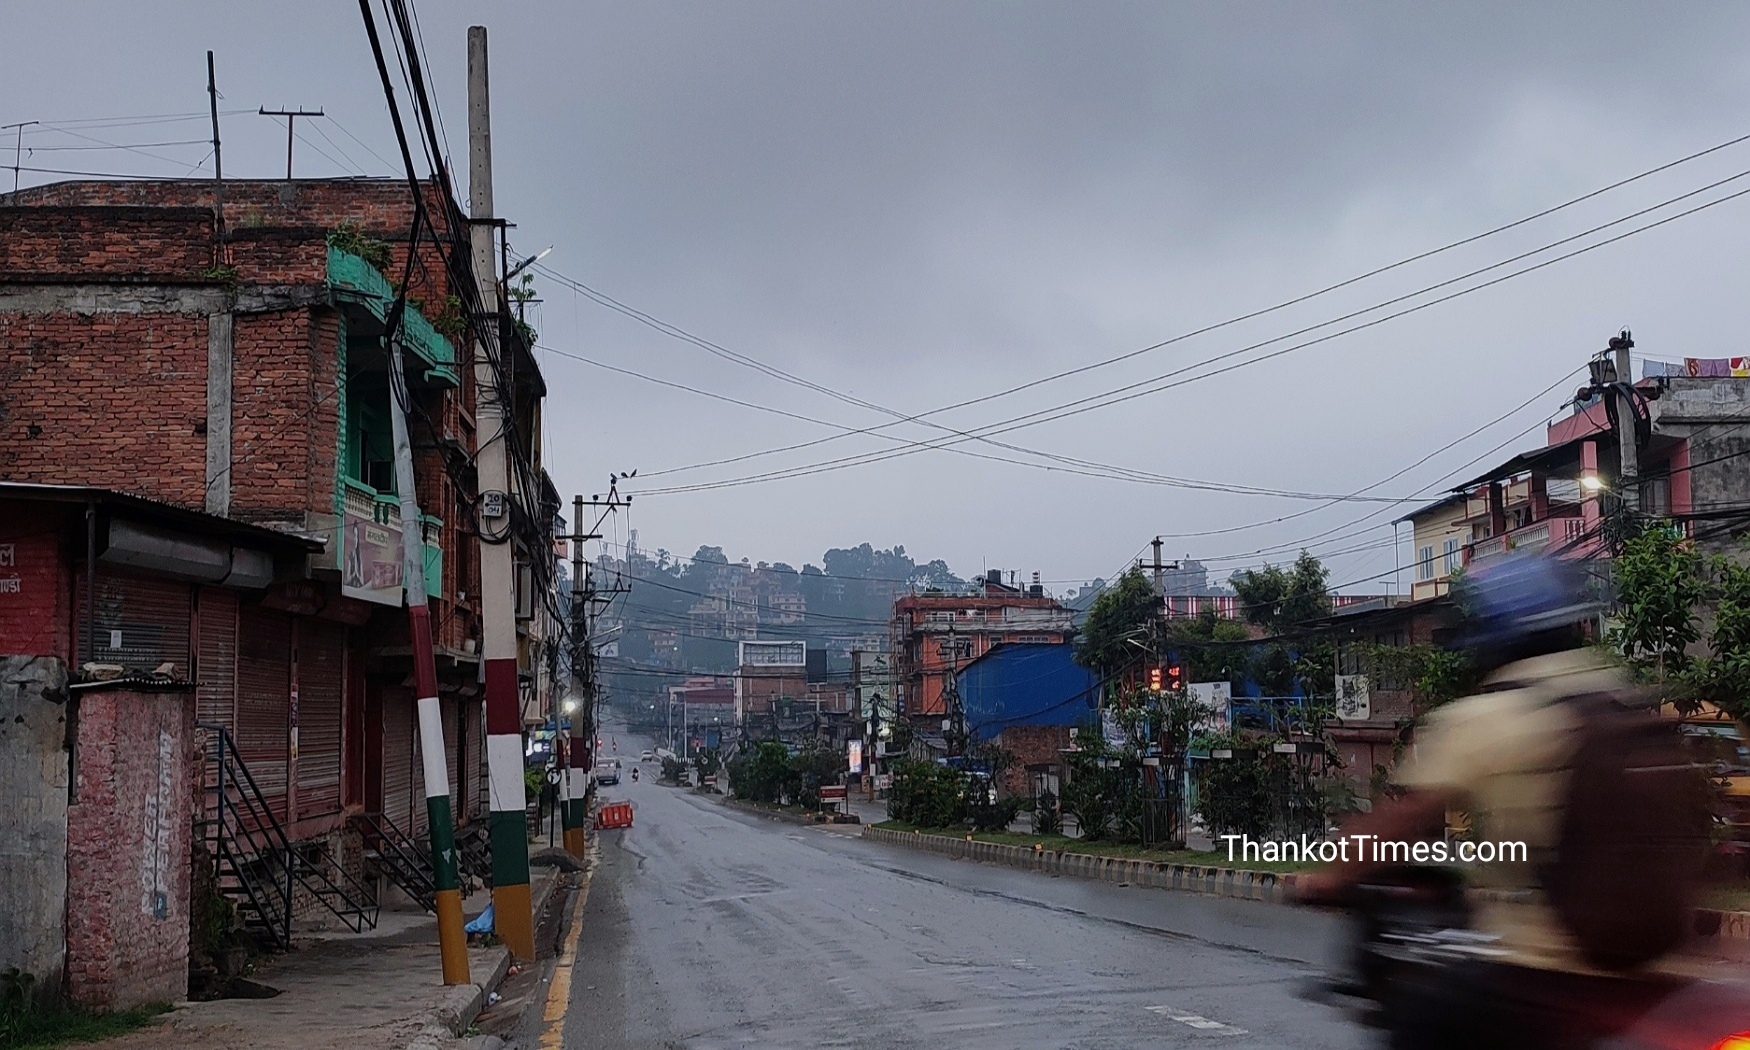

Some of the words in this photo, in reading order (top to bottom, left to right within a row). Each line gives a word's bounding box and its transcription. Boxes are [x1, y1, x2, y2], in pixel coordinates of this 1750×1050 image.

[488, 494, 500, 503] 20
[0, 543, 15, 567] ल
[142, 793, 156, 914] POWER
